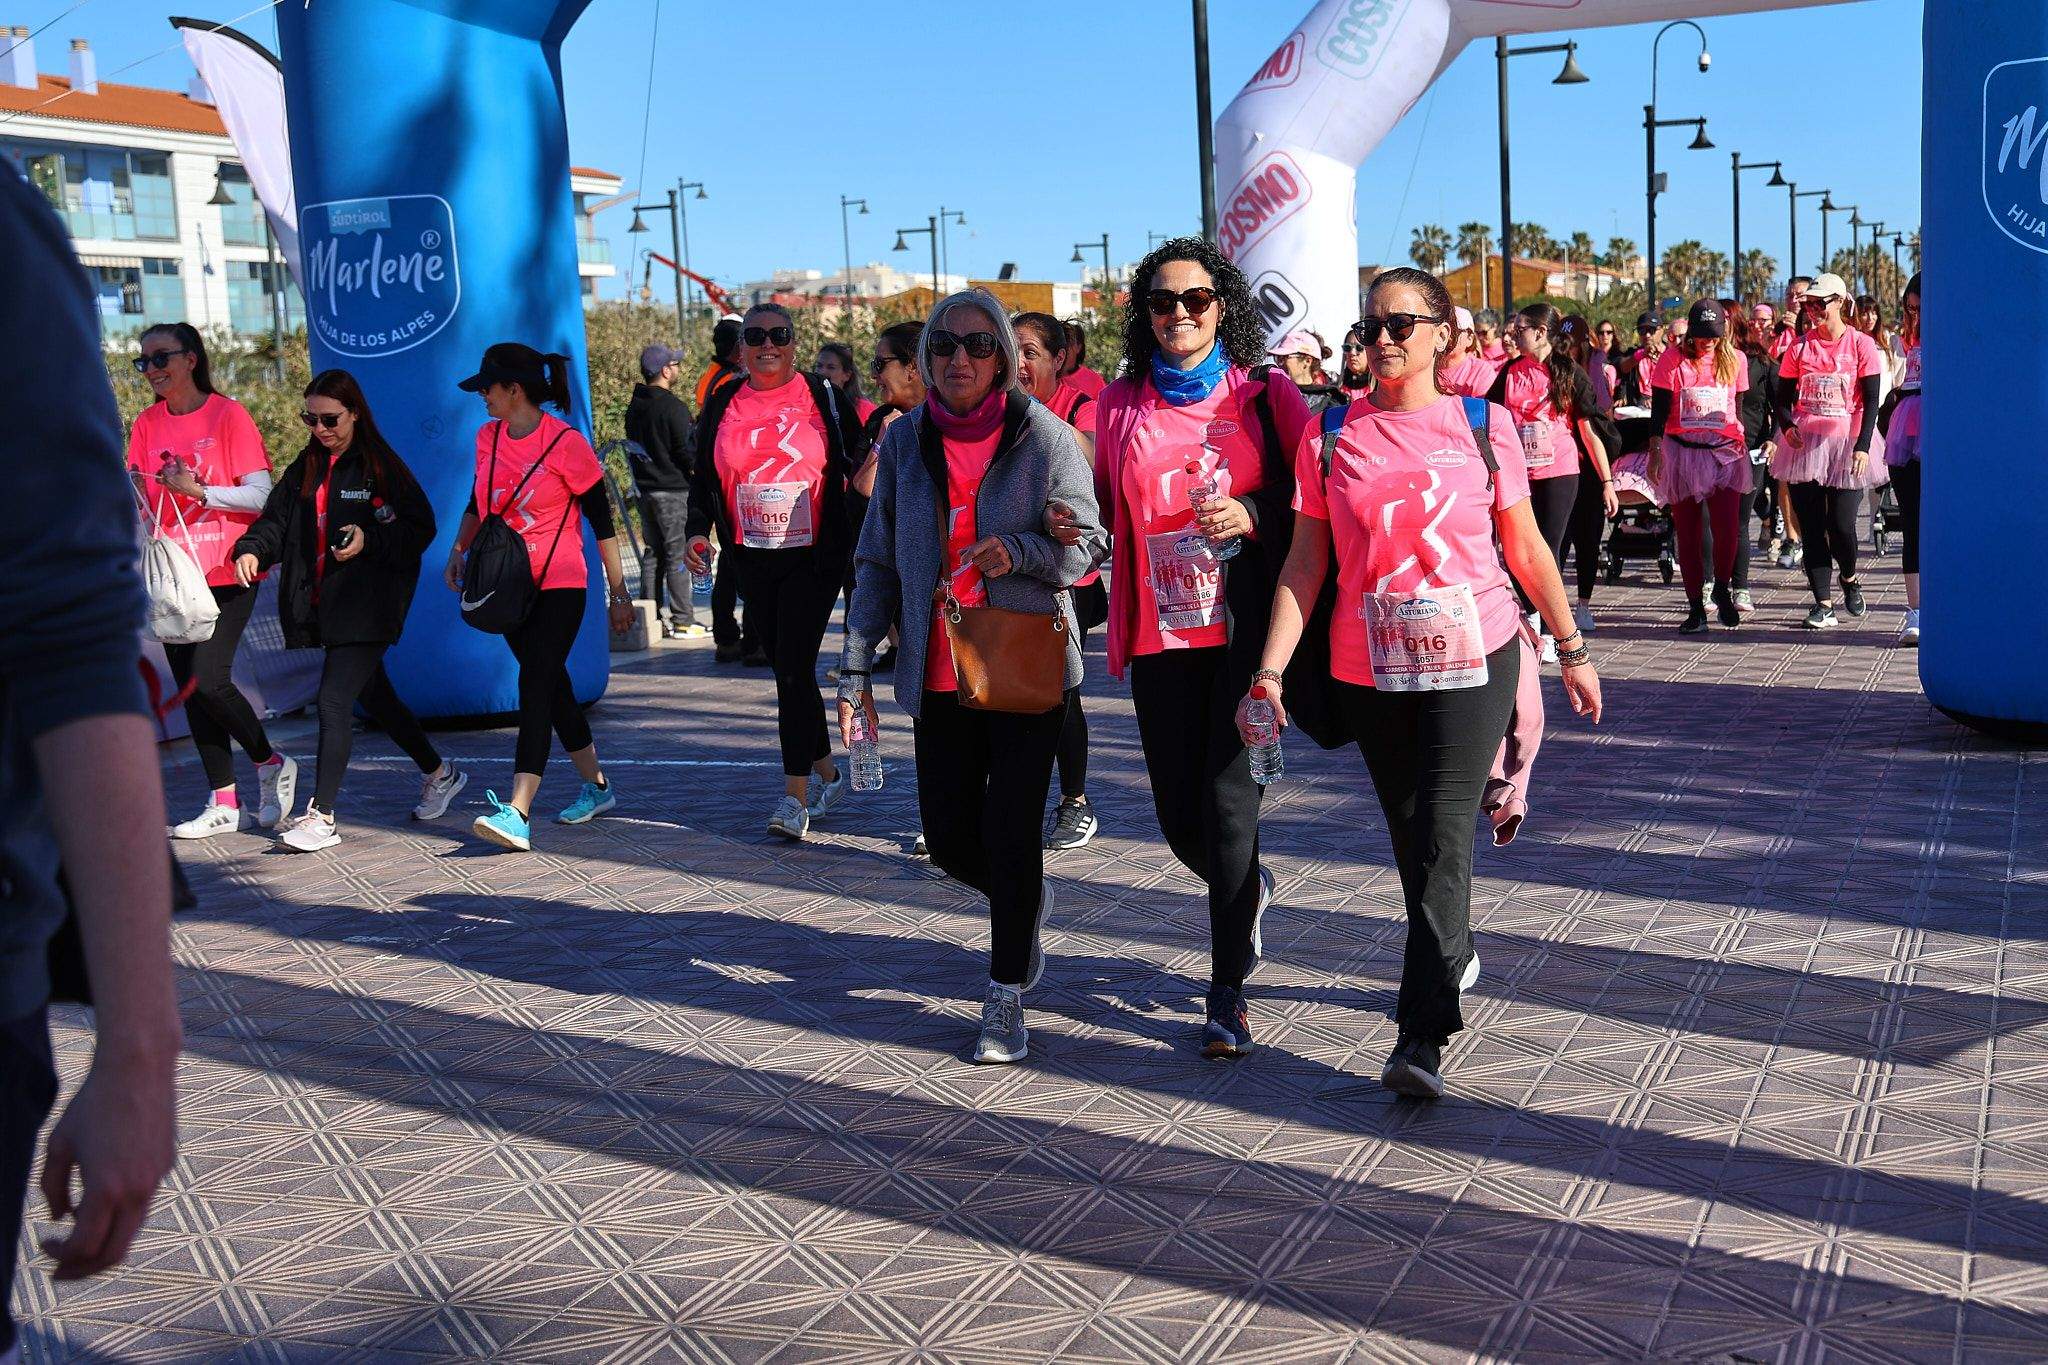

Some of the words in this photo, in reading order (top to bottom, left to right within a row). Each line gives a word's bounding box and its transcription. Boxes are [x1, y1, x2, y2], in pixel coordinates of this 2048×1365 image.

[1327, 0, 1394, 66] COS
[1218, 163, 1299, 261] COSMO
[2007, 203, 2046, 238] HIJA
[310, 232, 445, 317] Marlene
[341, 331, 356, 346] DE
[360, 332, 387, 347] LOS
[391, 309, 435, 343] ALPES
[761, 512, 789, 524] 016
[1183, 568, 1219, 590] 016
[1192, 590, 1212, 601] 6186
[1398, 605, 1439, 617] ASTURIANA
[1404, 634, 1448, 654] 016
[1440, 673, 1475, 683] Santander
